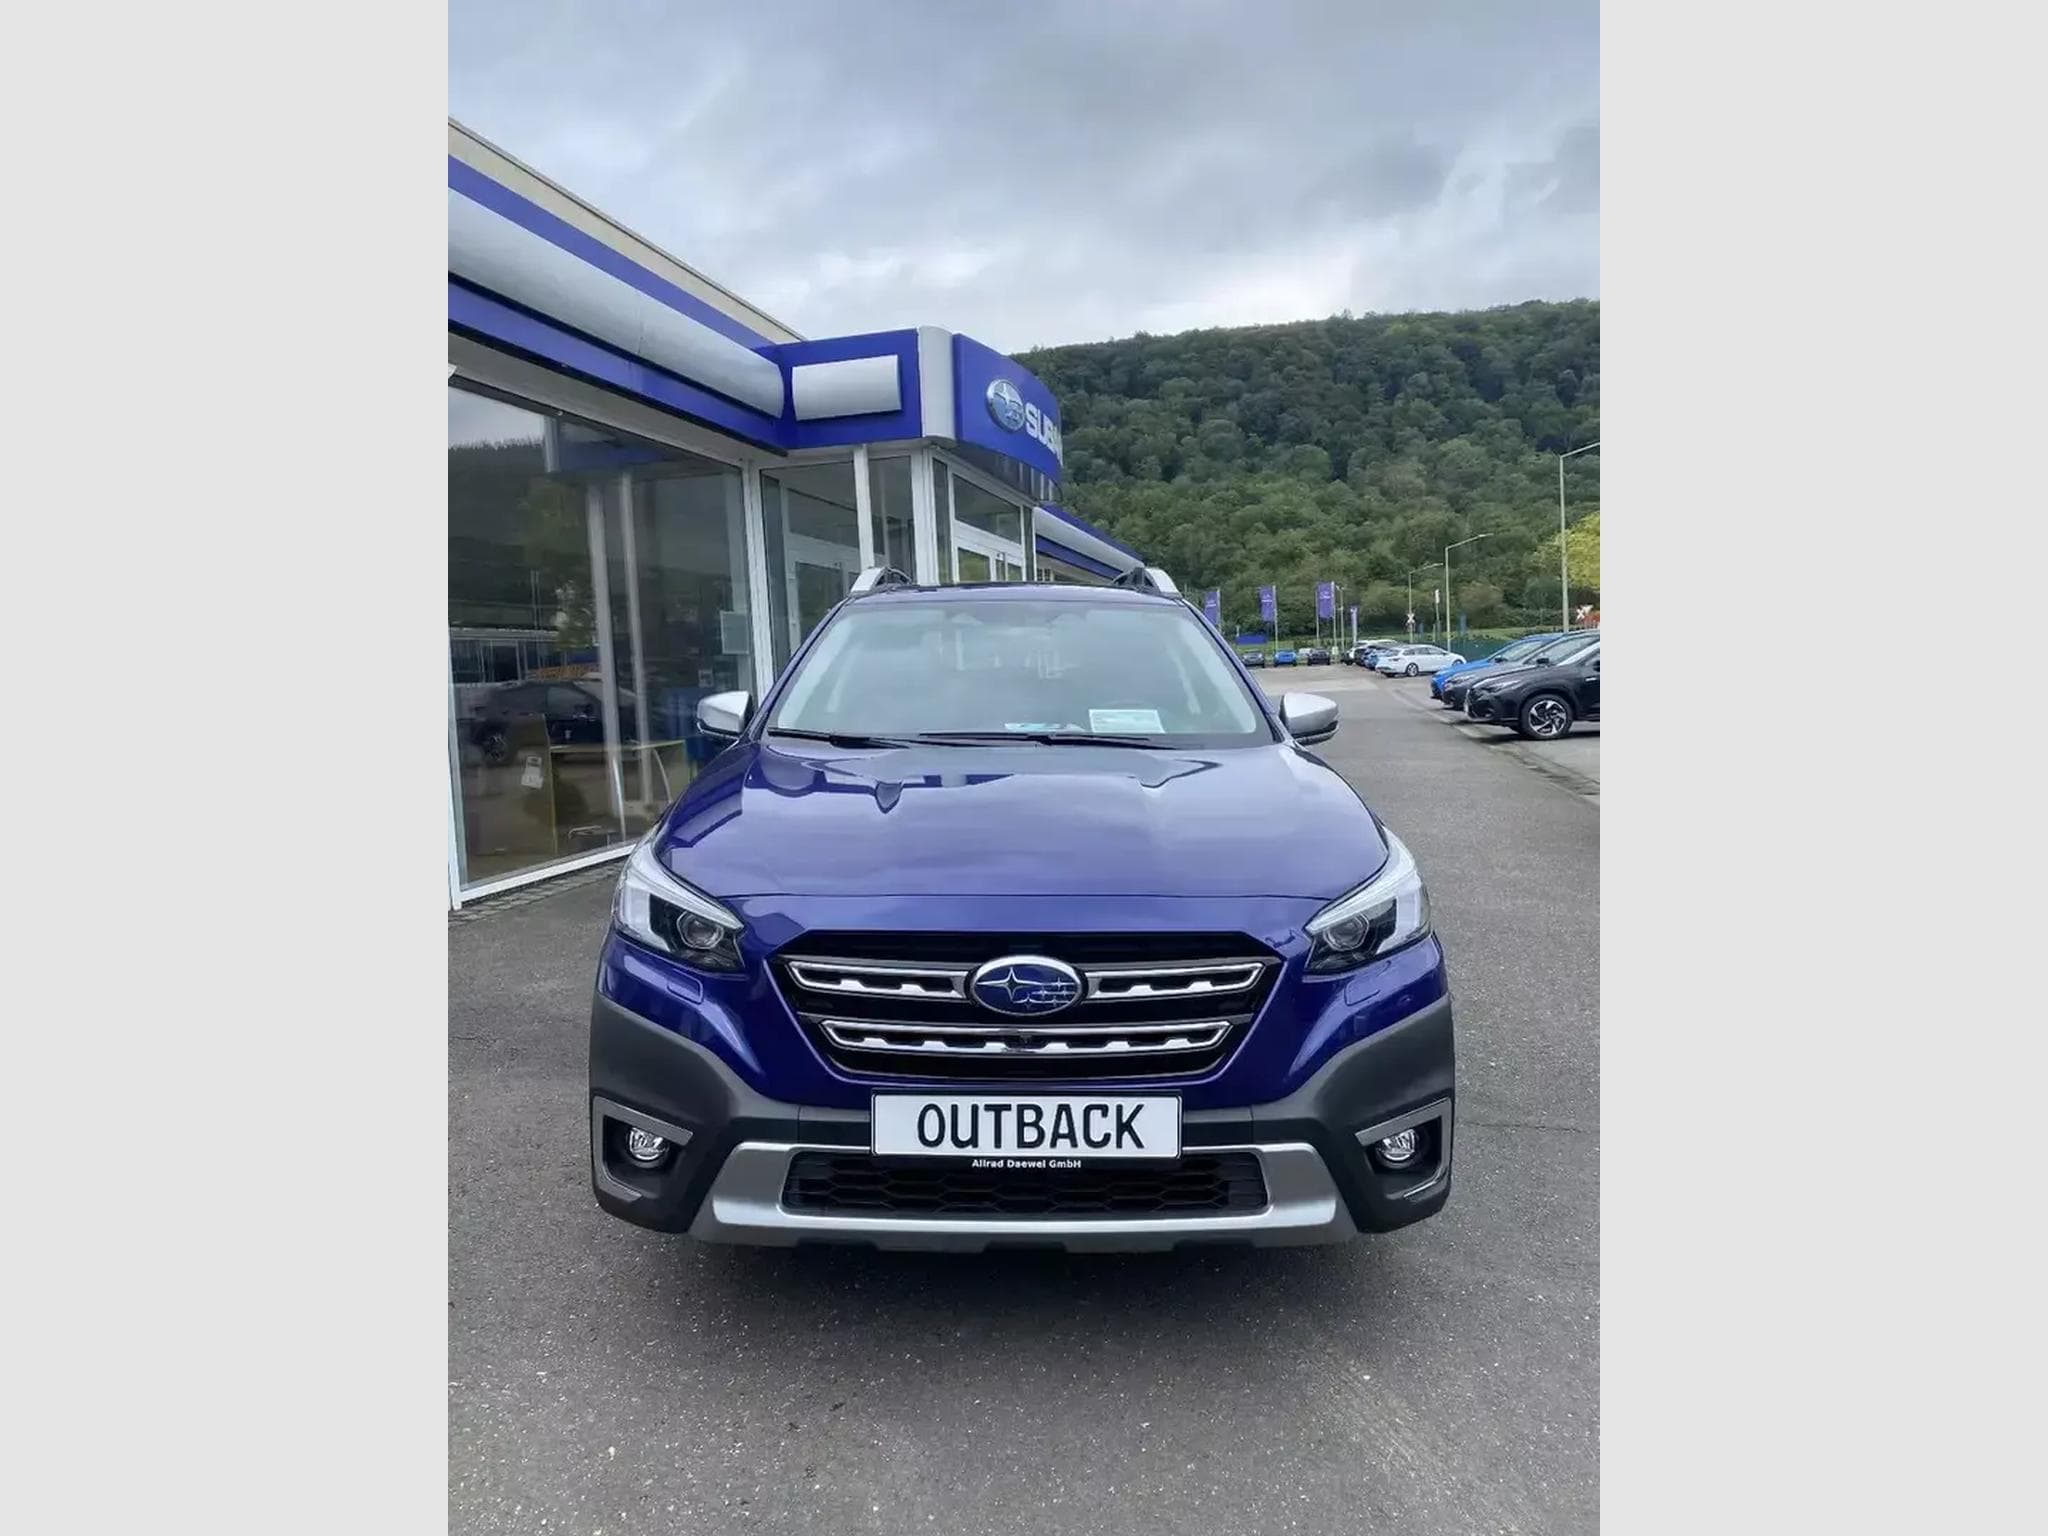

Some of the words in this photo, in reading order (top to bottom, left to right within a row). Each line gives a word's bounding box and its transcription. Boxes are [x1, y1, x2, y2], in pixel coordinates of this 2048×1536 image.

[916, 1102, 1146, 1150] OUTBACK
[971, 1158, 1004, 1169] Allrad
[1048, 1158, 1082, 1169] GmbH
